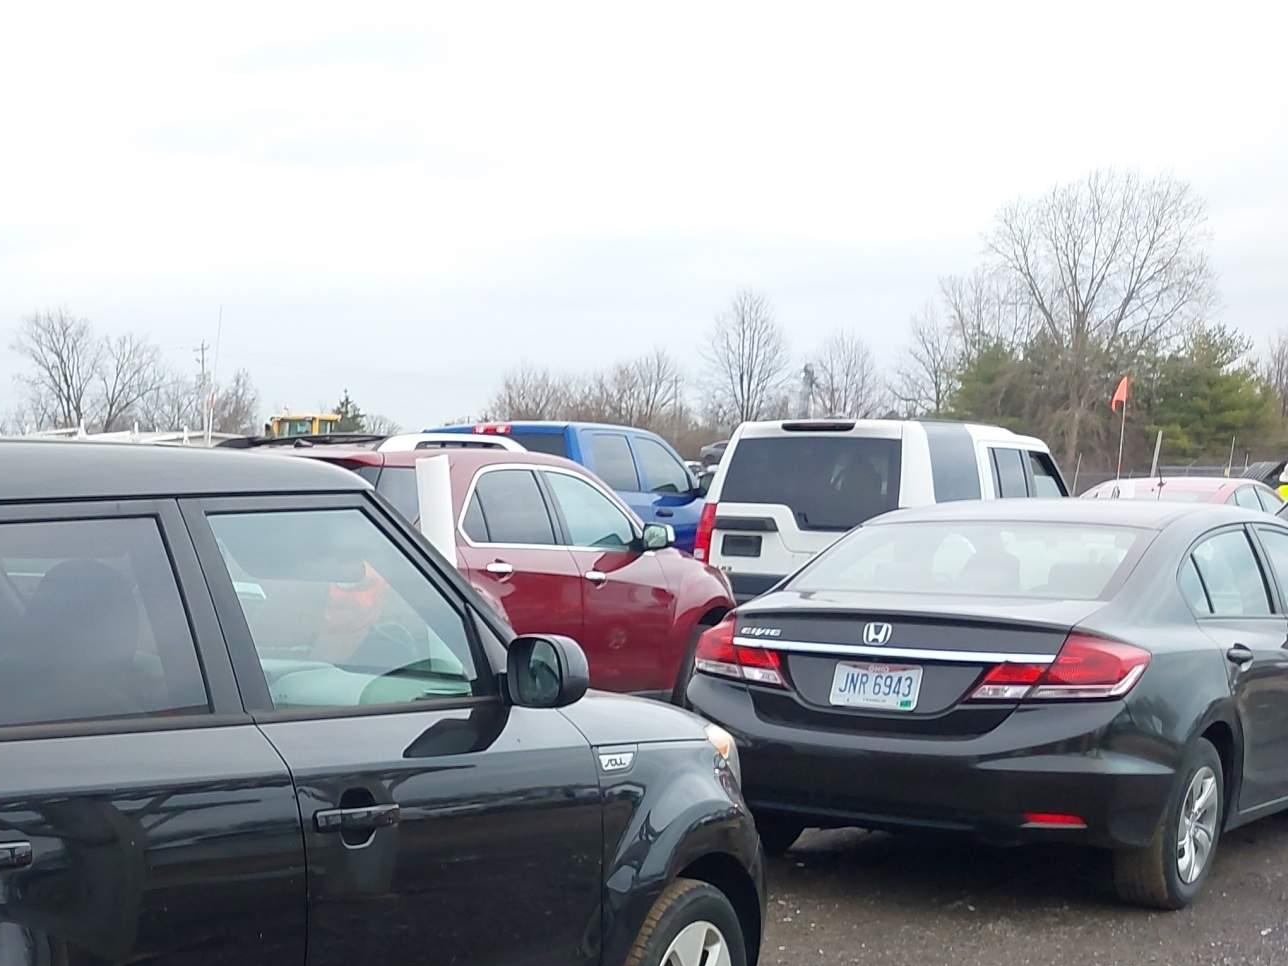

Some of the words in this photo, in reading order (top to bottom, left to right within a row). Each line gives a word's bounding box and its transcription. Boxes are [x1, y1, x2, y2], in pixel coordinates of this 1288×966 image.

[741, 627, 782, 636] CIVIC
[839, 672, 869, 694] JNR
[872, 674, 913, 698] 6943
